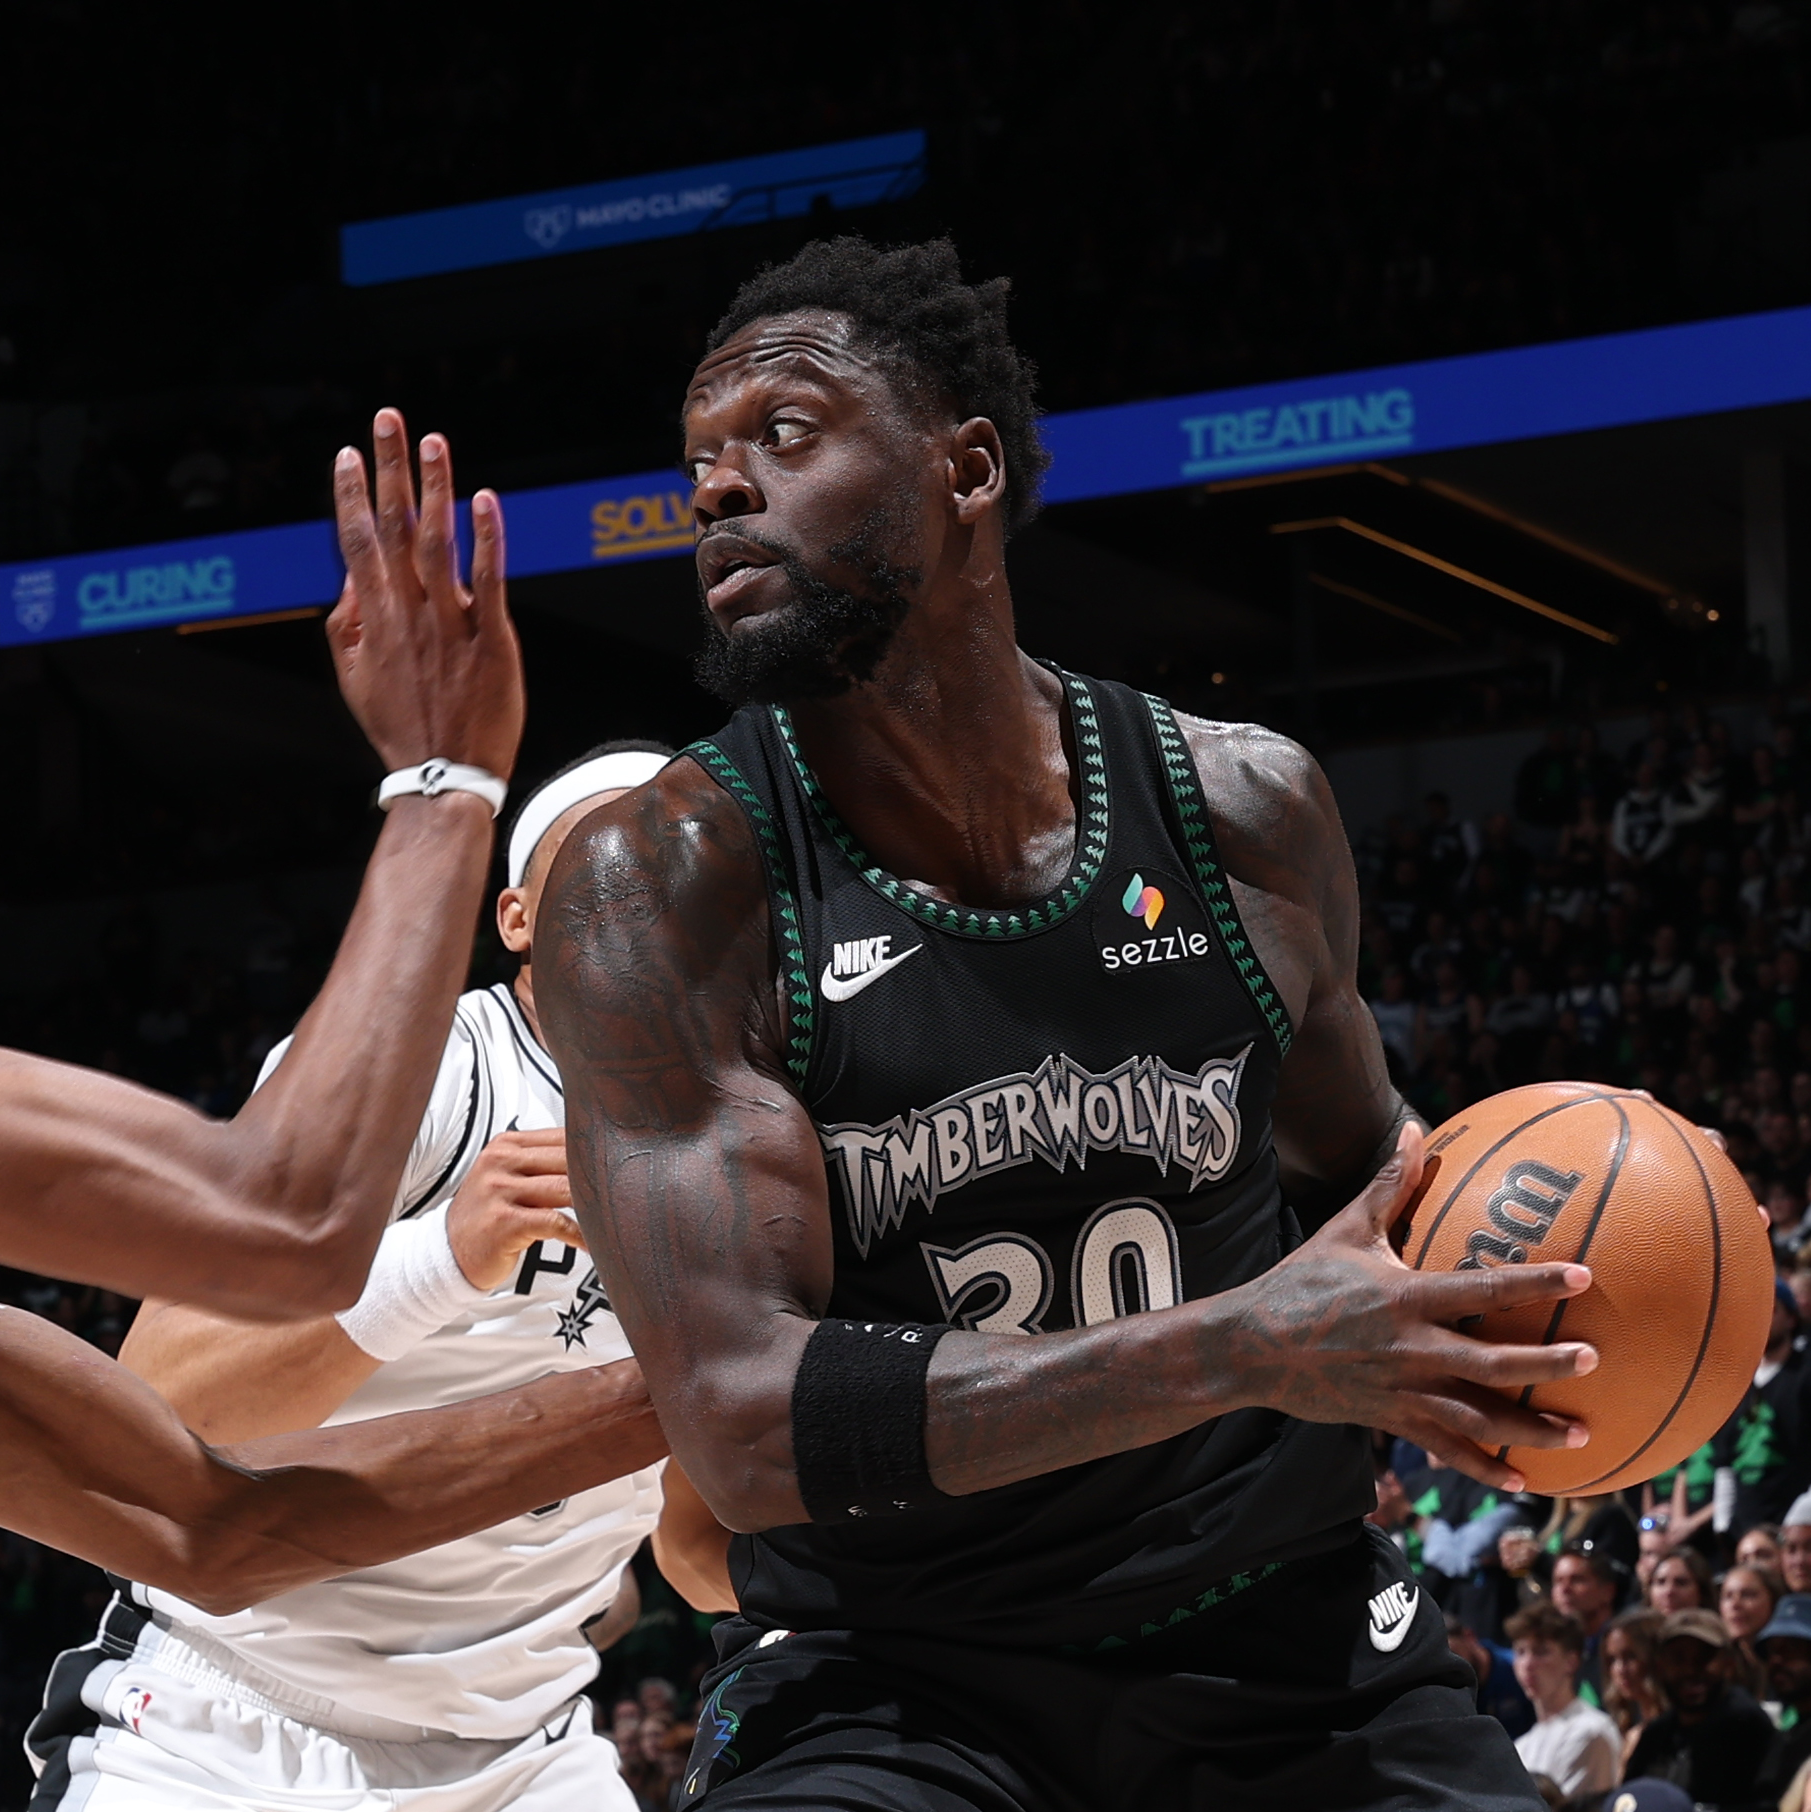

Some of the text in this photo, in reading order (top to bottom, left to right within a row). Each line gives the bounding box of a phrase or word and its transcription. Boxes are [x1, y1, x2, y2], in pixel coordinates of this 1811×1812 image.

[575, 184, 731, 229] MAYO CLINIC
[1180, 388, 1414, 460] TREATING
[78, 556, 235, 612] CURING
[833, 935, 892, 976] NIKE
[1101, 926, 1209, 969] sezzle
[818, 1041, 1255, 1261] TIMBERWOLVES
[1367, 1581, 1410, 1630] NIKE
